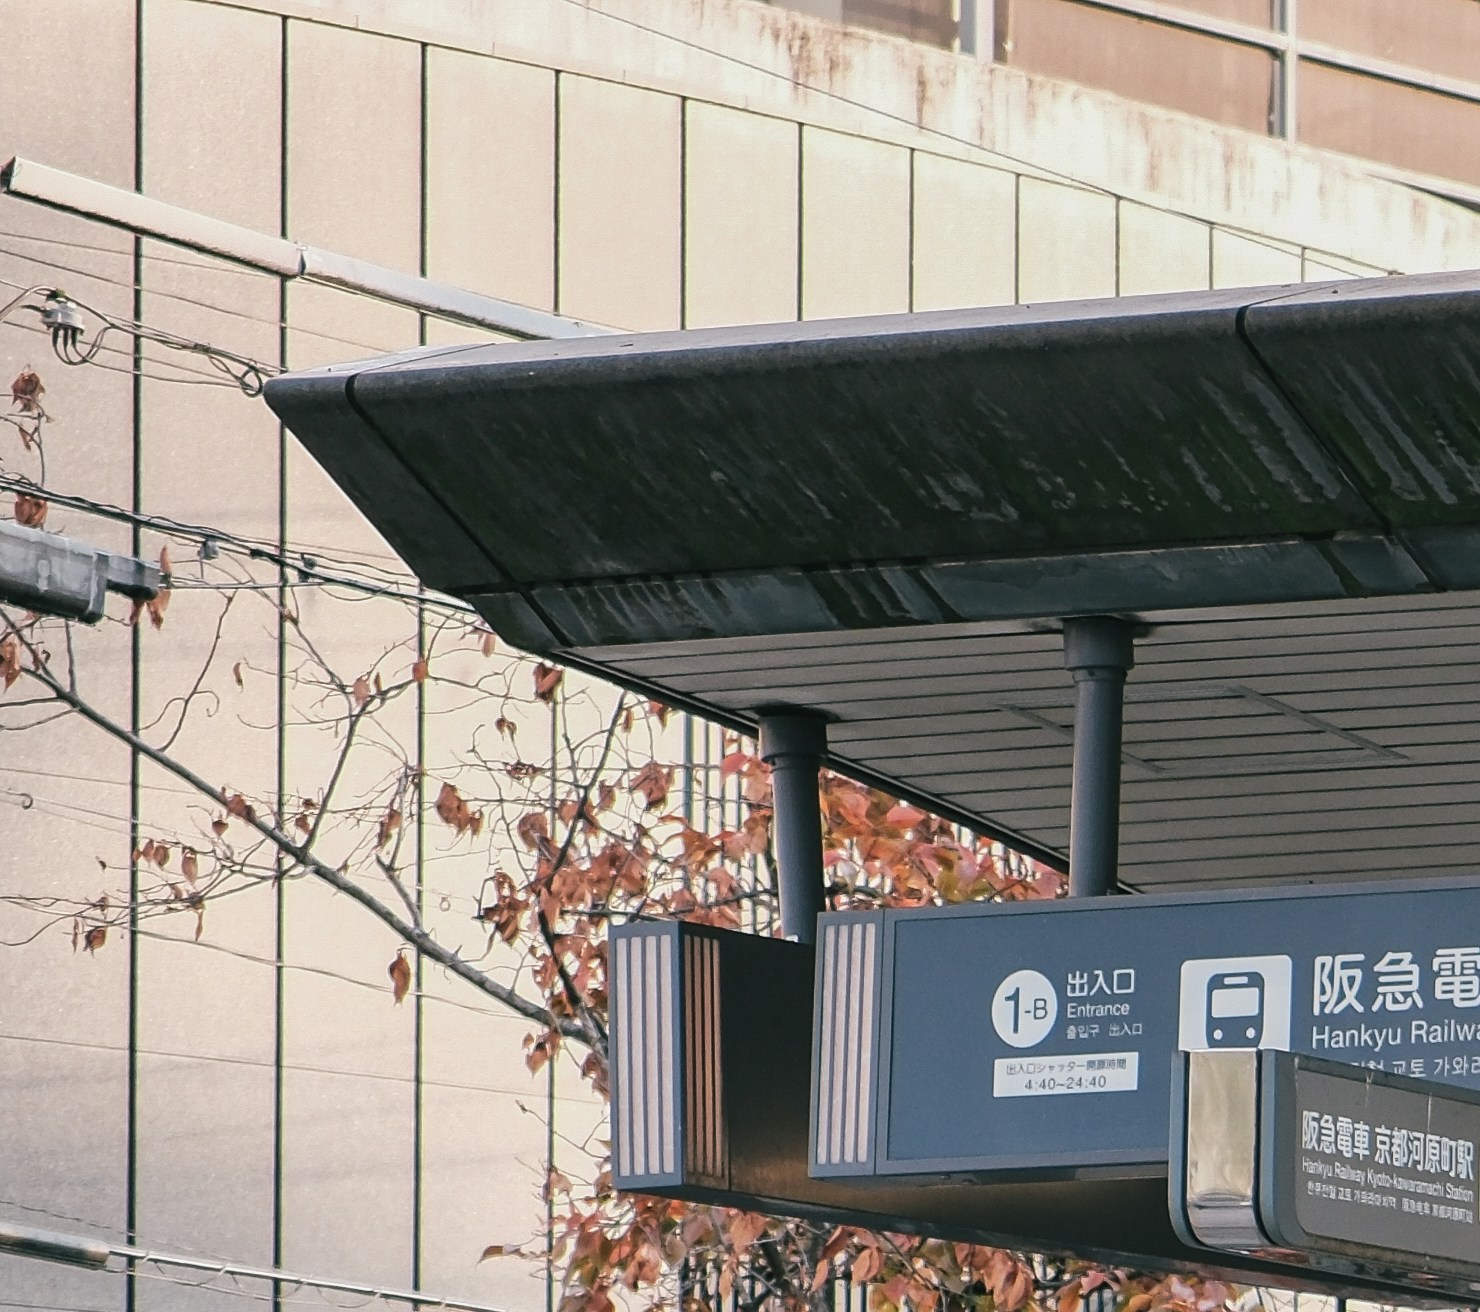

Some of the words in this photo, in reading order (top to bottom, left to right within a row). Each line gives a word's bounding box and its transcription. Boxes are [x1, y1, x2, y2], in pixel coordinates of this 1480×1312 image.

[1066, 969, 1135, 997] 出入口
[1005, 987, 1048, 1034] 1-B
[1066, 1003, 1130, 1018] Entrance
[1109, 1023, 1142, 1036] 出入口
[1312, 1024, 1401, 1051] Hankyu
[1302, 1110, 1370, 1160] 阪急電車
[1374, 1124, 1474, 1180] 京都河原町駅
[1302, 1156, 1332, 1179] Hankyu
[1335, 1161, 1366, 1187] Railway
[1367, 1168, 1444, 1197] Kyoto-kawaramachi
[1446, 1182, 1473, 1202] Station
